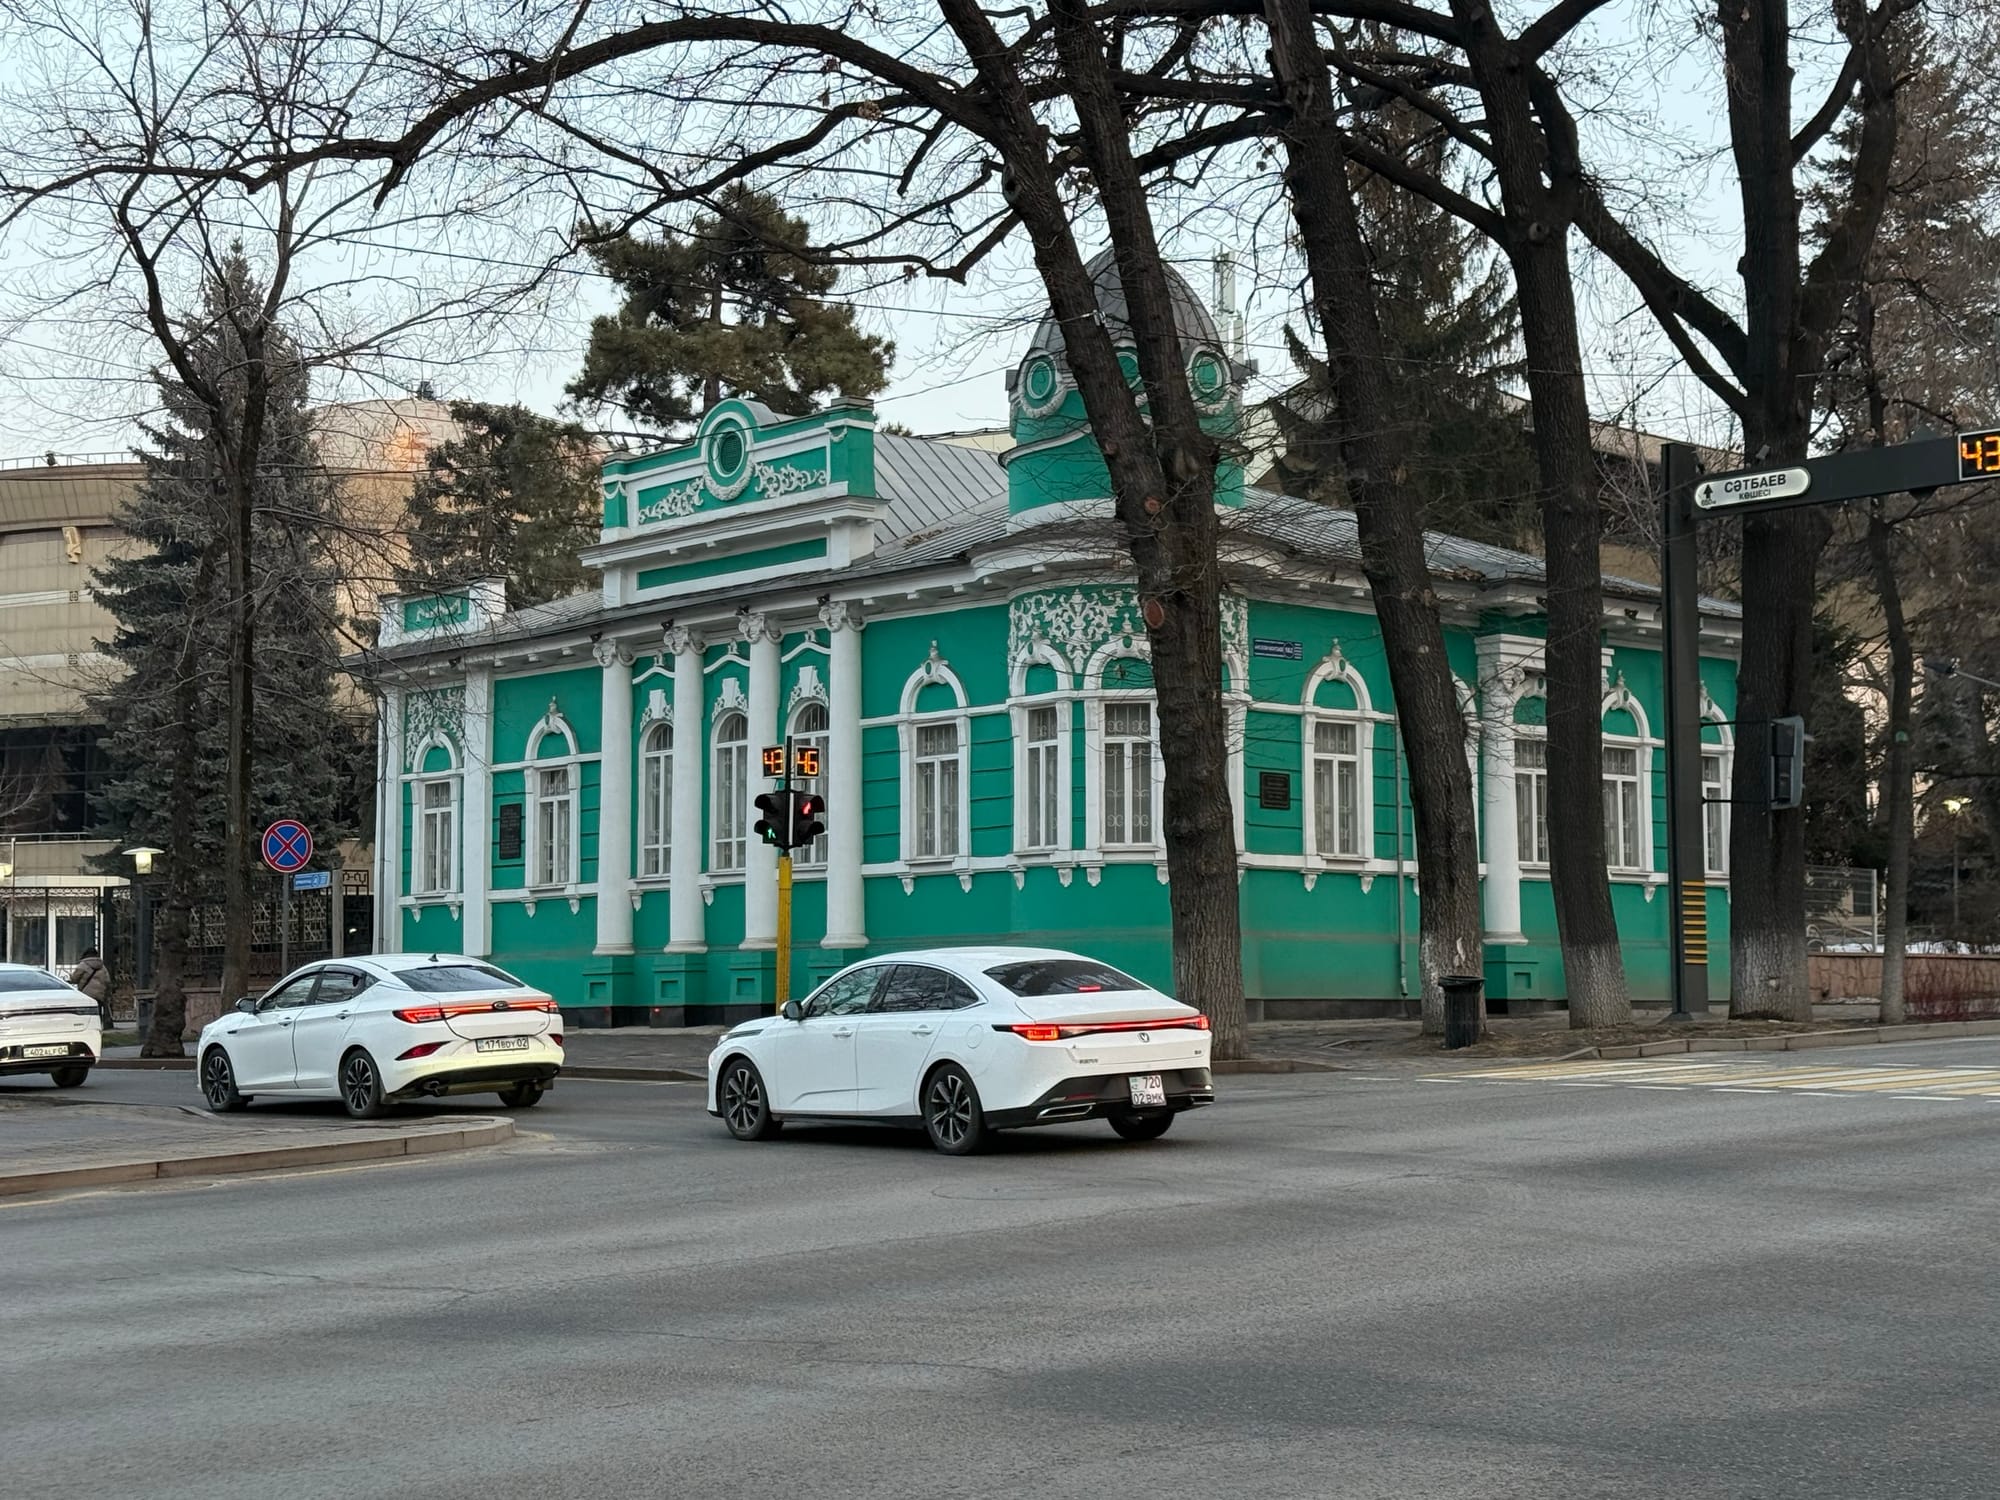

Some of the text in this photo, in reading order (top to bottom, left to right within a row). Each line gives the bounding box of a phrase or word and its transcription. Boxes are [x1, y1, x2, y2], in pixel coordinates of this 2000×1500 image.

[1962, 435, 2000, 471] 43
[1724, 473, 1787, 493] СӘТБАЕВ
[1739, 489, 1771, 500] КӨШЕСІ
[764, 749, 784, 773] 43
[797, 751, 818, 775] 46
[1142, 1076, 1161, 1089] 720
